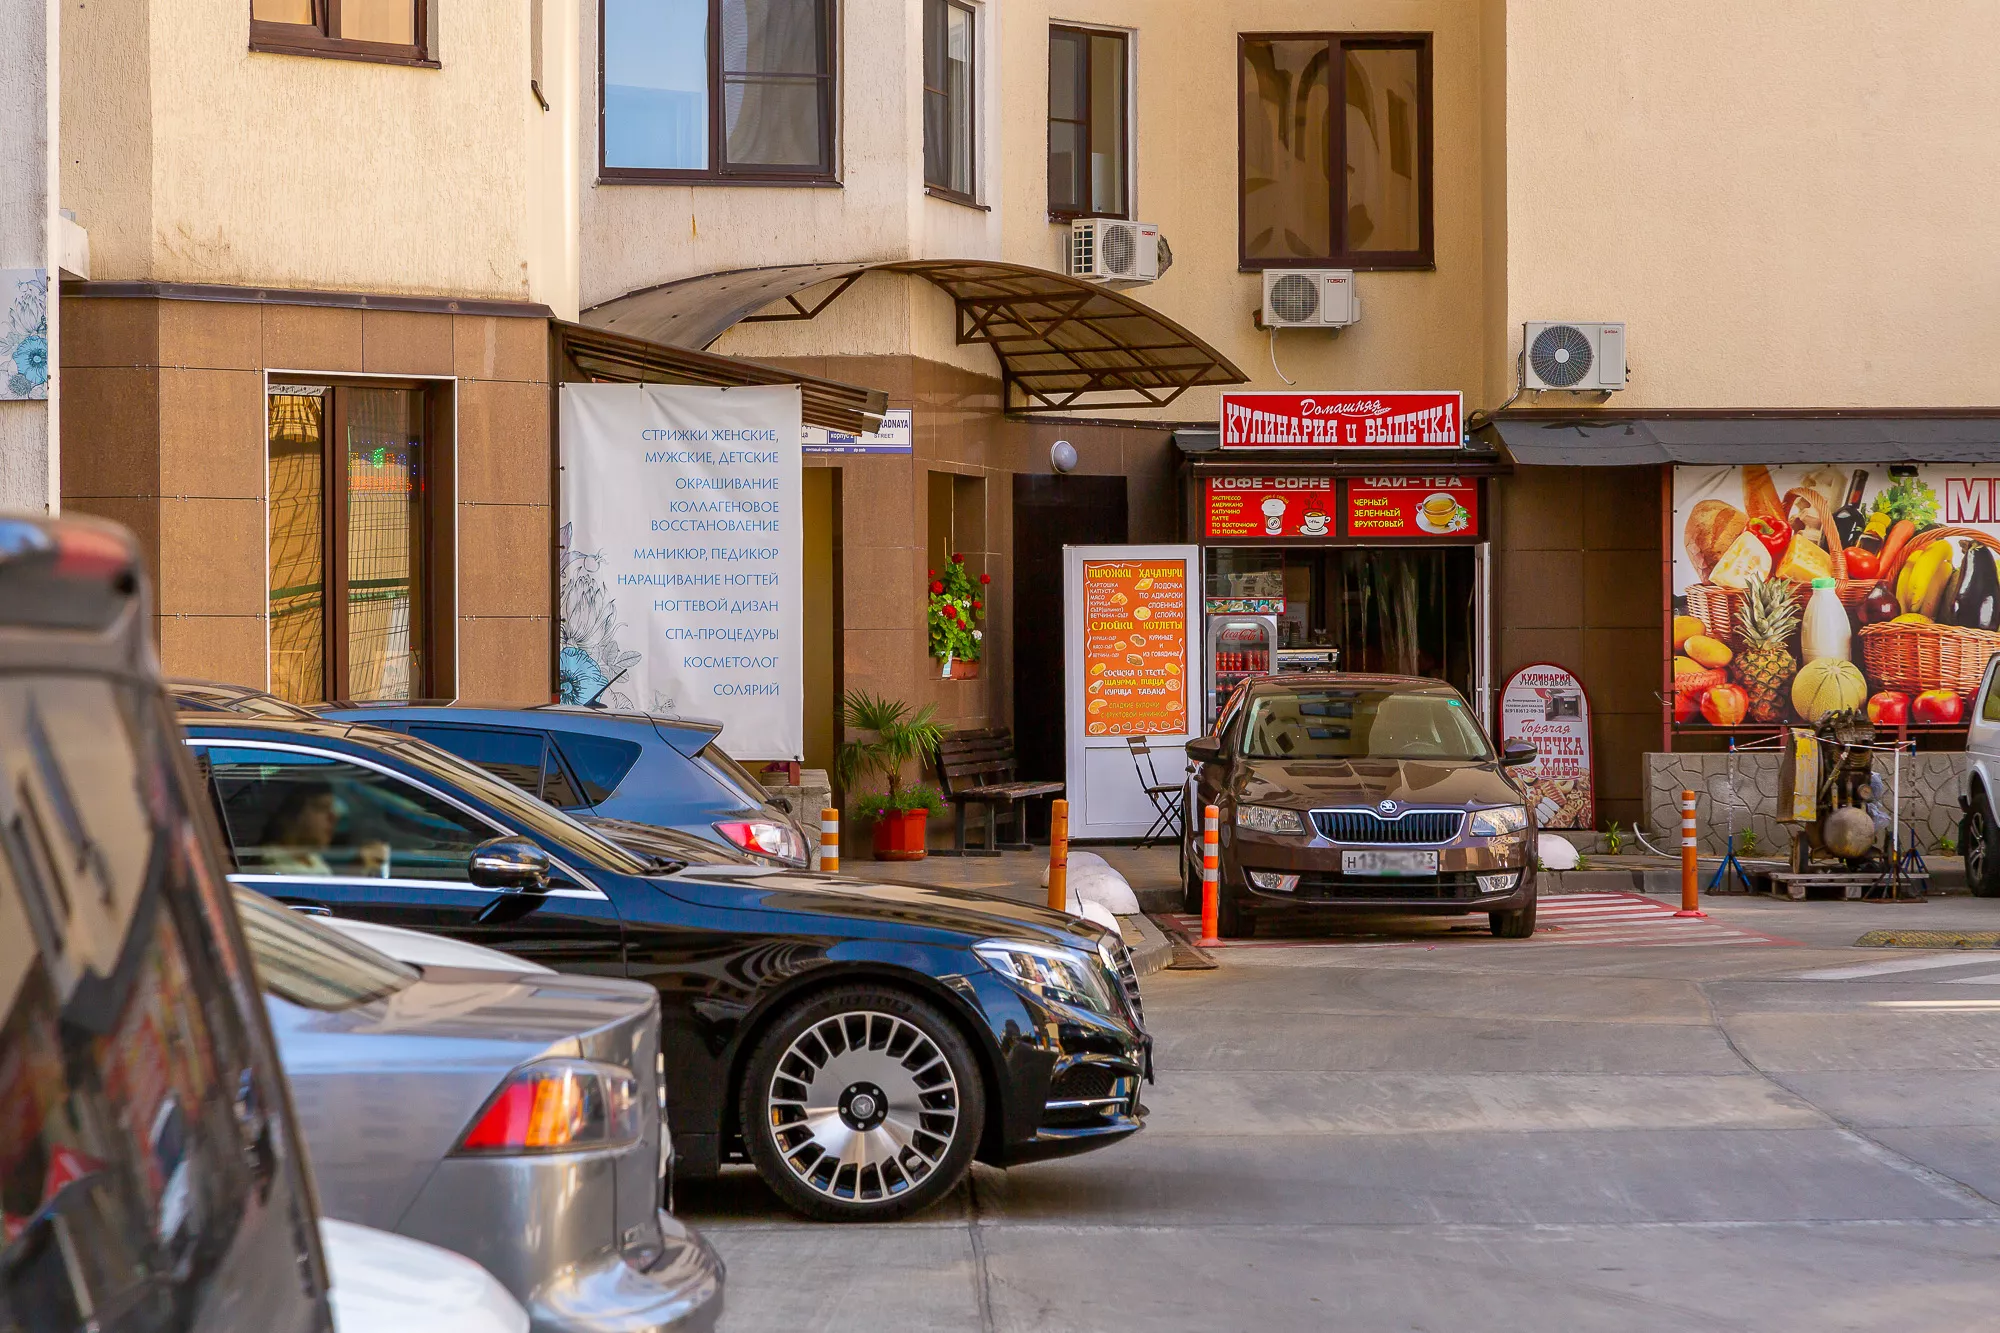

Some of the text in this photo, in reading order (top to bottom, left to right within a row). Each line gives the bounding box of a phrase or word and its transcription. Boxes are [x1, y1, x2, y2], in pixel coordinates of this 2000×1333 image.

[1300, 398, 1382, 416] Домашняя
[880, 420, 908, 428] RADNAYA
[1226, 402, 1456, 444] КУЛИНАРИЯ и ВЫПЕЧКА
[642, 430, 779, 443] СТРИЖКИ ЖЕНСКИЕ,
[645, 452, 779, 465] МУЖСКИЕ, ДЕТСКИЕ
[675, 478, 779, 490] ОКРАШИВАНИЕ
[1212, 478, 1330, 488] КОФЕ-COFFE
[670, 501, 779, 513] КОЛЛАГЕНОВОЕ
[1354, 498, 1388, 506] ЧЕРНЫЙ
[1354, 508, 1400, 517] ЗЕЛЕННЫЙ
[651, 520, 779, 532] ВОССТАНОВЛЕНИЕ
[1354, 519, 1404, 528] ФРУКТОВЫЙ
[634, 548, 779, 562] МАНИКЮР, ПЕДИКЮР
[1089, 568, 1132, 578] ПИРОЖКИ
[1138, 568, 1182, 578] ХАЧАПУРИ
[617, 572, 779, 588] НАРАЩИВАНИЕ НОГТЕЙ
[654, 598, 779, 614] НОГТЕВОЙ ДИЗАН
[1092, 621, 1134, 630] СЛОЙКИ
[1144, 621, 1182, 630] КОТЛЕТЫ
[665, 628, 779, 642] СПА-ПРОЦЕДУРЫ
[684, 656, 779, 668] КОСМЕТОЛОГ
[1522, 674, 1570, 682] КУЛИНАРИЯ
[713, 682, 779, 696] СОЛЯРИЙ
[1521, 719, 1571, 736] Горячая
[1509, 736, 1584, 756] ПЕЧКА
[1540, 758, 1580, 776] ХЛЕБ
